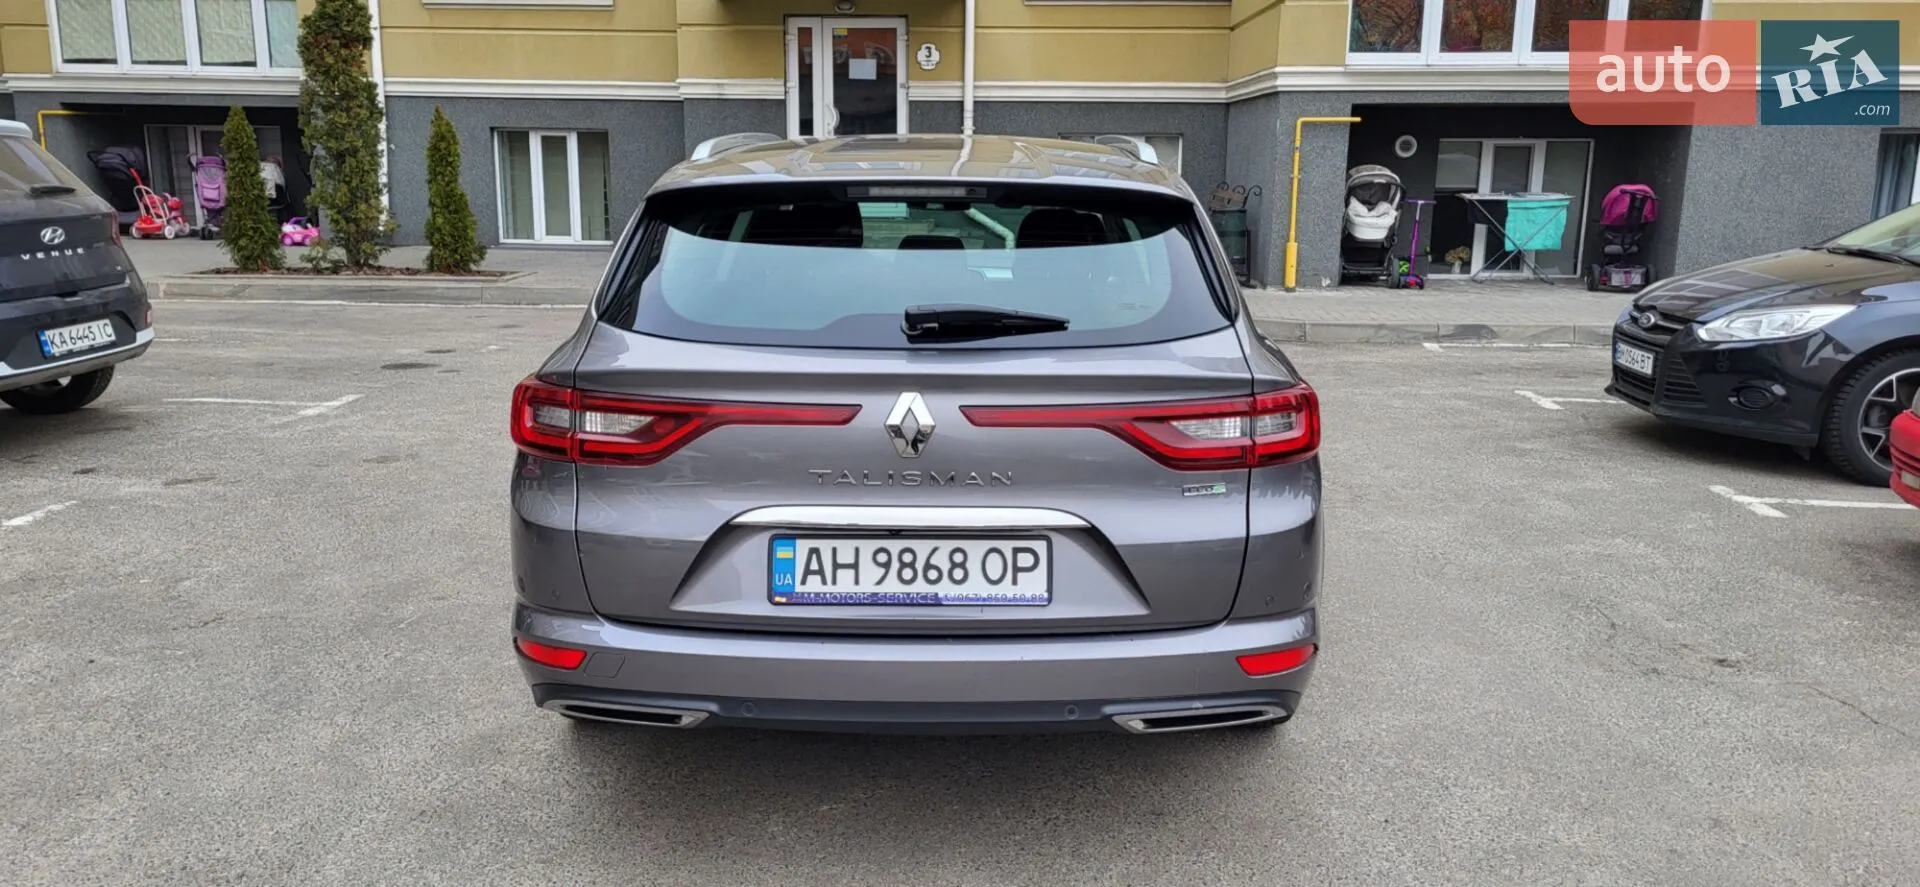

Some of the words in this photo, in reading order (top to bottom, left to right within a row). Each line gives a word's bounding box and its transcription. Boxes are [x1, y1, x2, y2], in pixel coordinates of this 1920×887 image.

[924, 45, 932, 59] 3
[20, 247, 85, 260] VENUE
[47, 331, 69, 351] KA
[69, 325, 96, 345] 6445
[97, 322, 113, 339] IC
[808, 469, 1013, 486] TALISMAN
[800, 546, 860, 586] AH
[872, 546, 969, 586] 9868
[981, 546, 1040, 586] OP
[775, 573, 793, 585] UA
